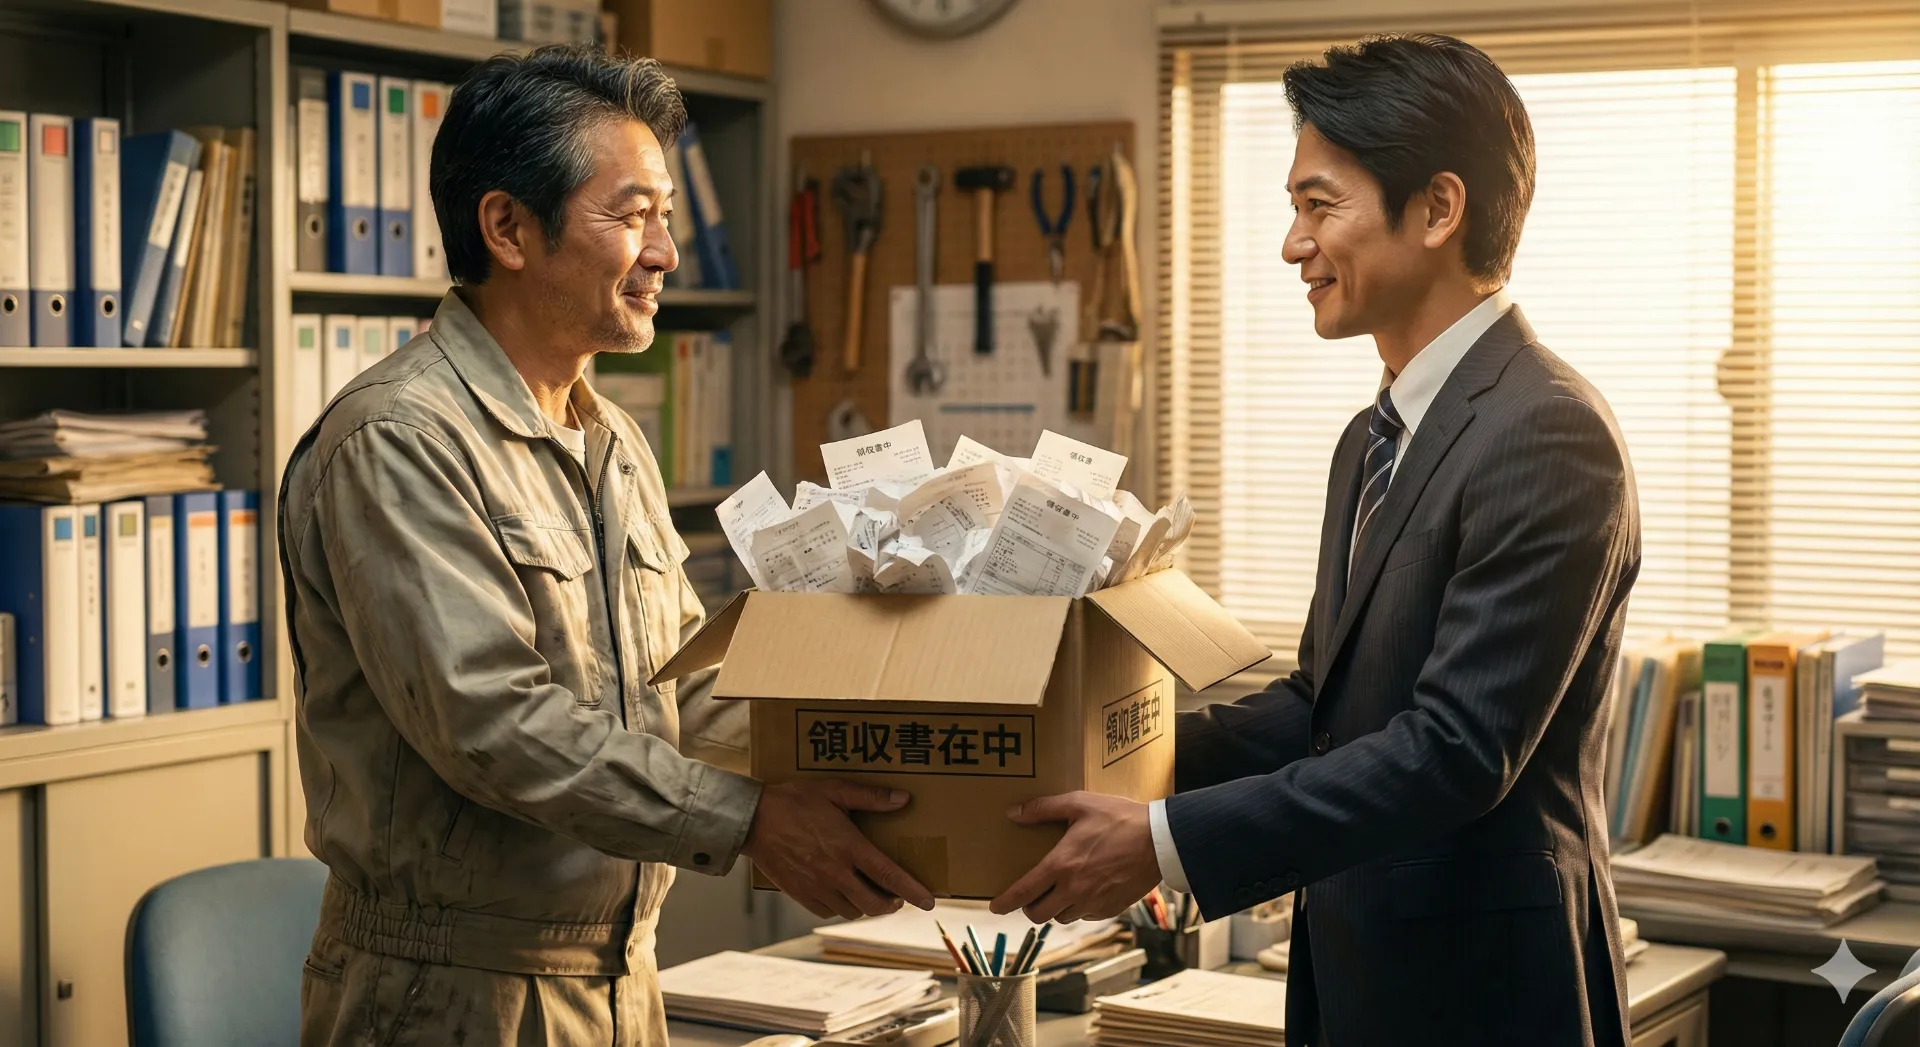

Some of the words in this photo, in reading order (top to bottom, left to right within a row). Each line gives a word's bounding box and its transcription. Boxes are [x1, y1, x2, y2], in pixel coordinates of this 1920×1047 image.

[808, 719, 1022, 768] 領収書在中
[1106, 690, 1160, 756] 領収書在中
